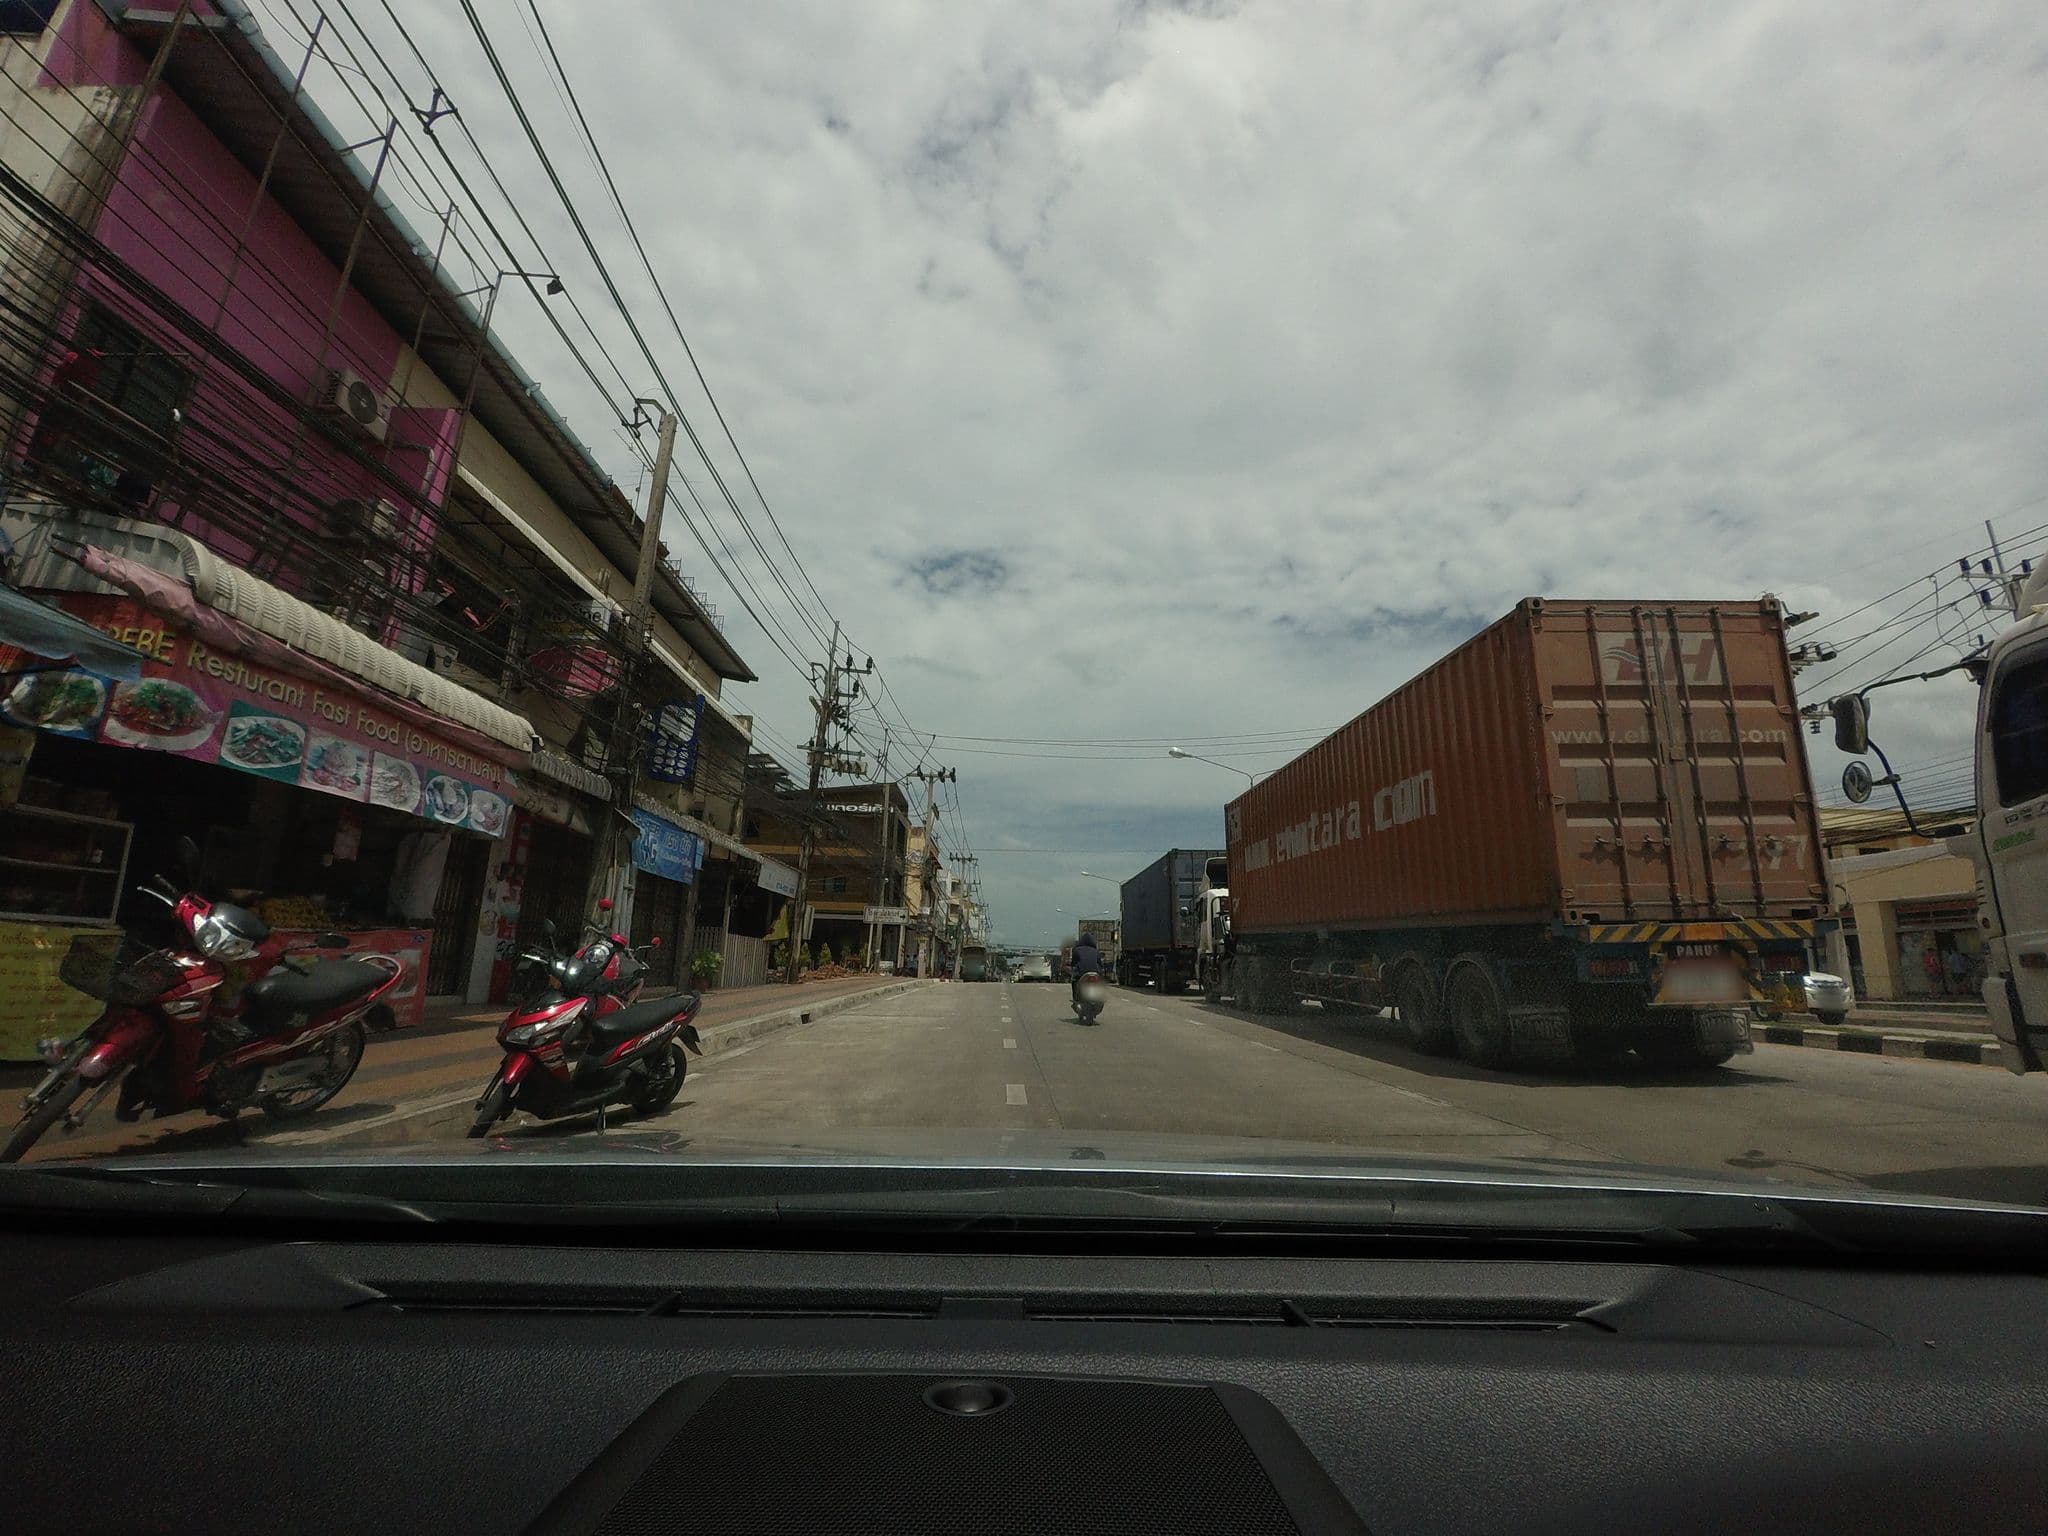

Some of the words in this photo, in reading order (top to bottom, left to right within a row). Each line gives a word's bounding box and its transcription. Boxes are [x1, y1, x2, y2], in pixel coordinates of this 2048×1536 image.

[186, 641, 304, 707] Resturant
[313, 691, 353, 729] Fast
[356, 711, 401, 745] Food
